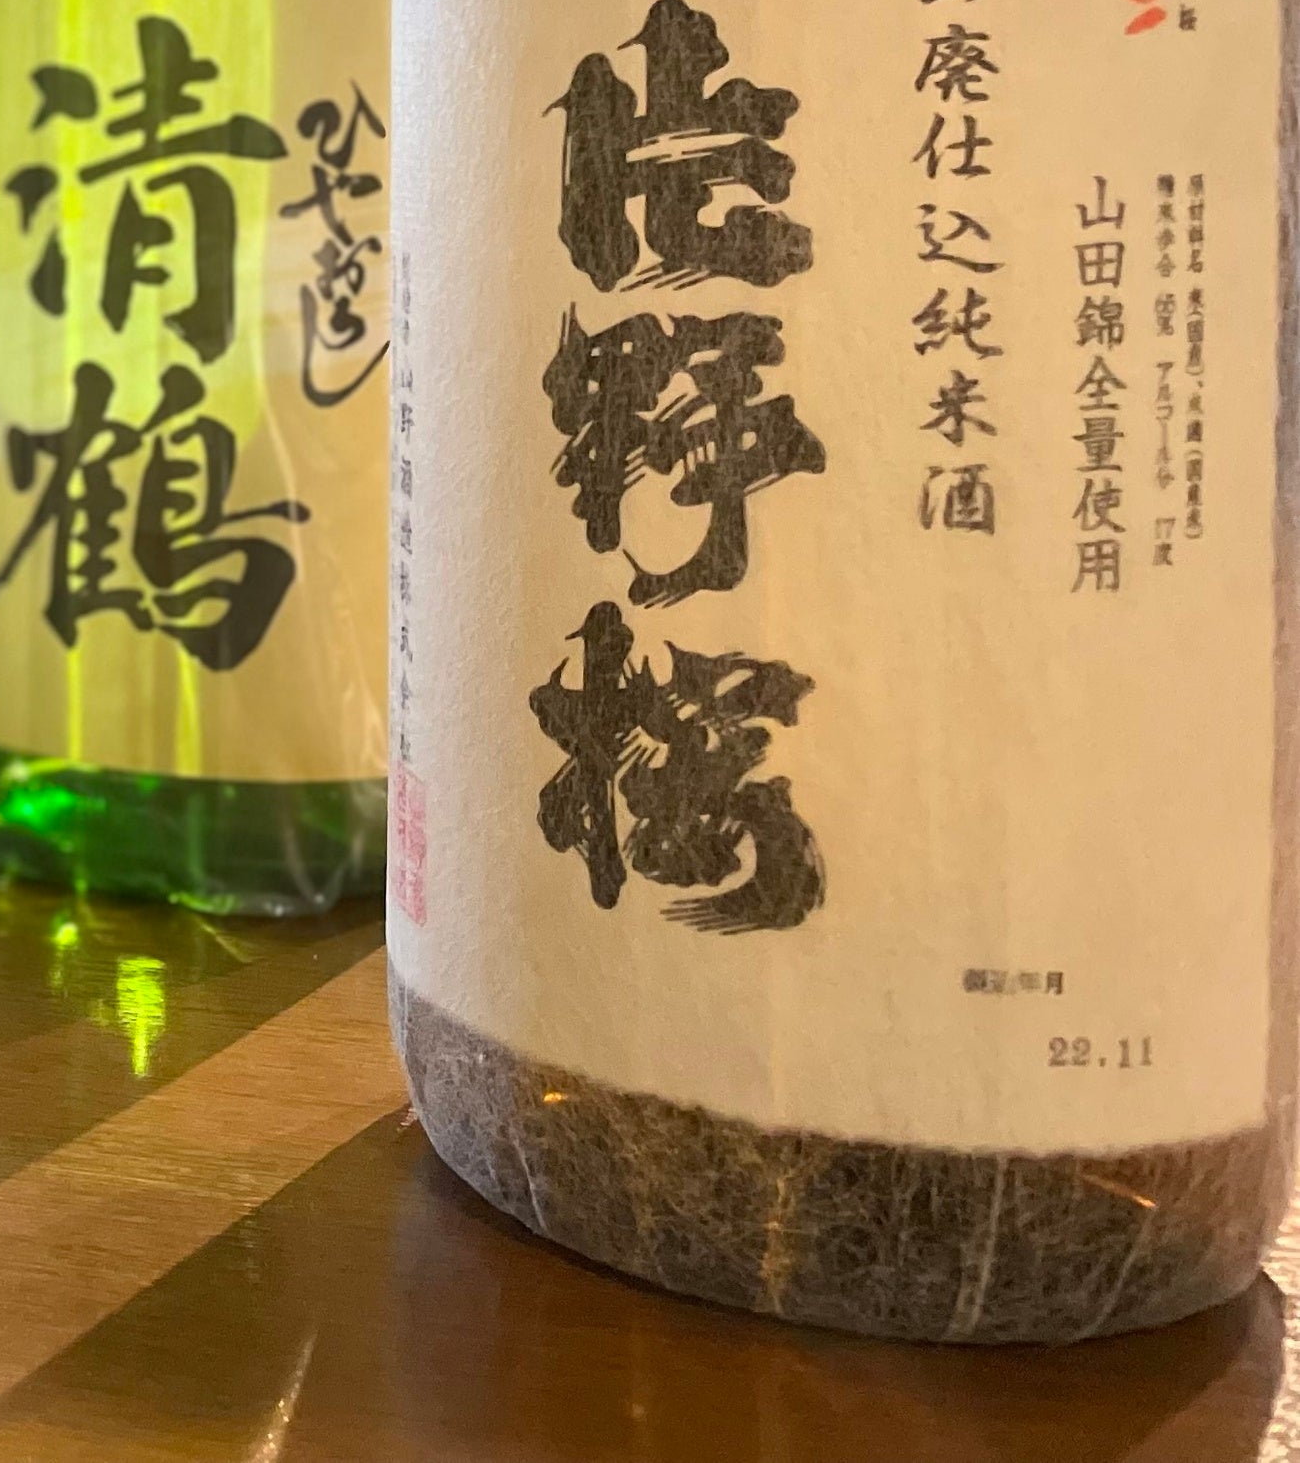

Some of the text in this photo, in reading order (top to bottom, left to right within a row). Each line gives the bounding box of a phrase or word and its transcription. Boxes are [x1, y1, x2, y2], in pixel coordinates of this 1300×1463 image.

[1071, 175, 1128, 595] 山田錦全量使用
[1048, 1036, 1152, 1069] 22.11
